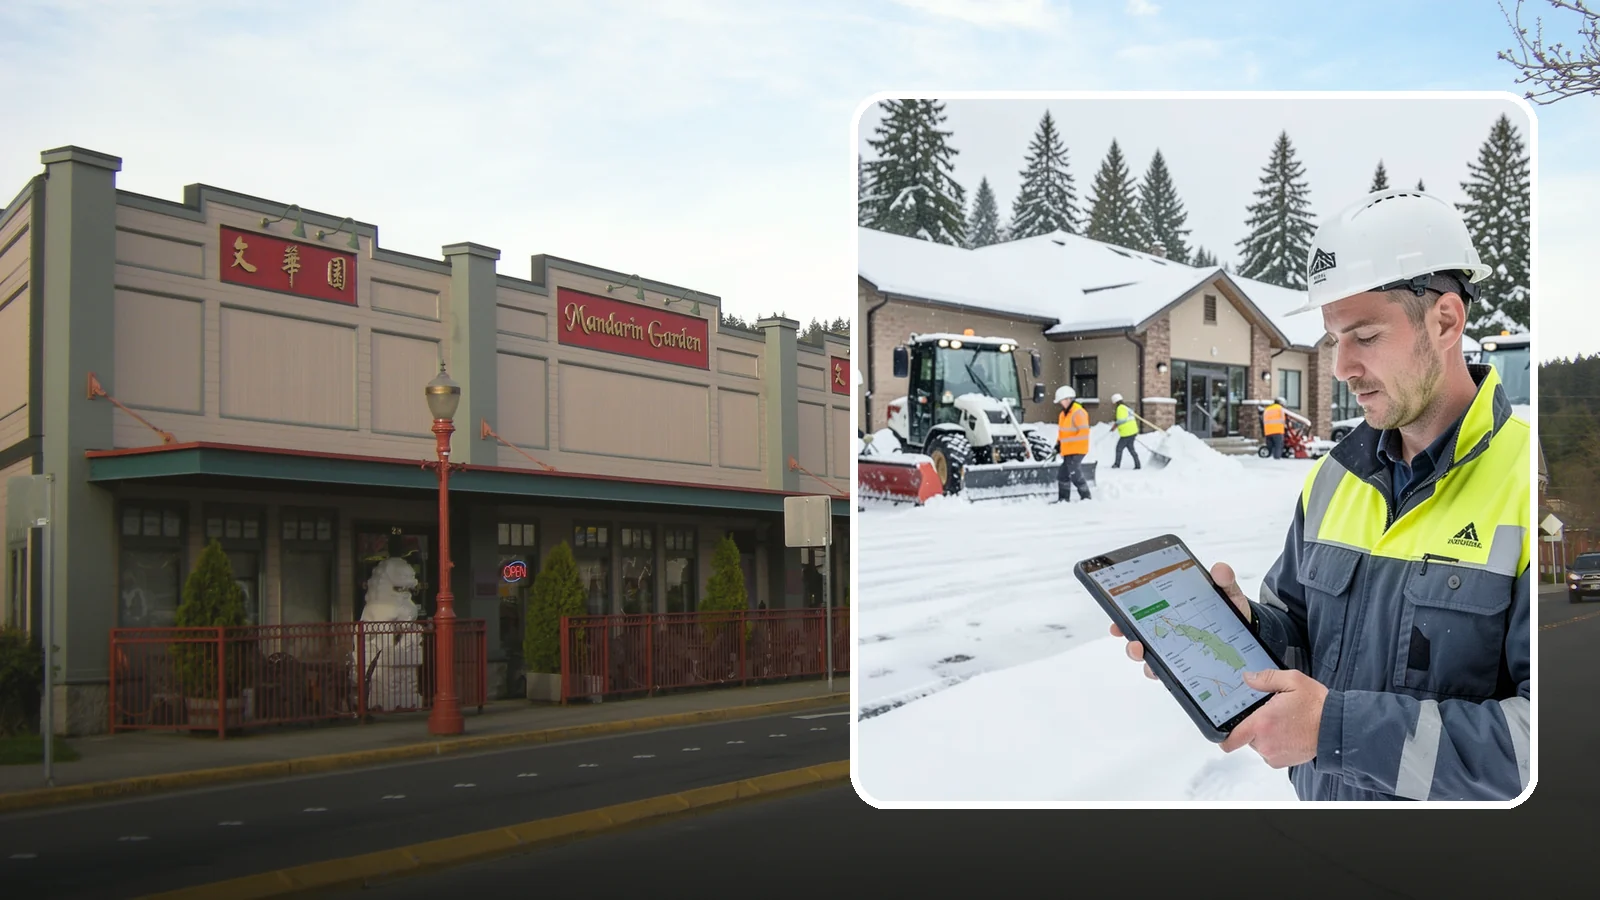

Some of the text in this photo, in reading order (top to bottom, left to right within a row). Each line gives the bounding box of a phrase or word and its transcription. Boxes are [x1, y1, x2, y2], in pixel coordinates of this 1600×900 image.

[231, 235, 346, 291] 文華園
[564, 302, 702, 352] Mandarin Garden
[503, 565, 527, 579] OPEN
